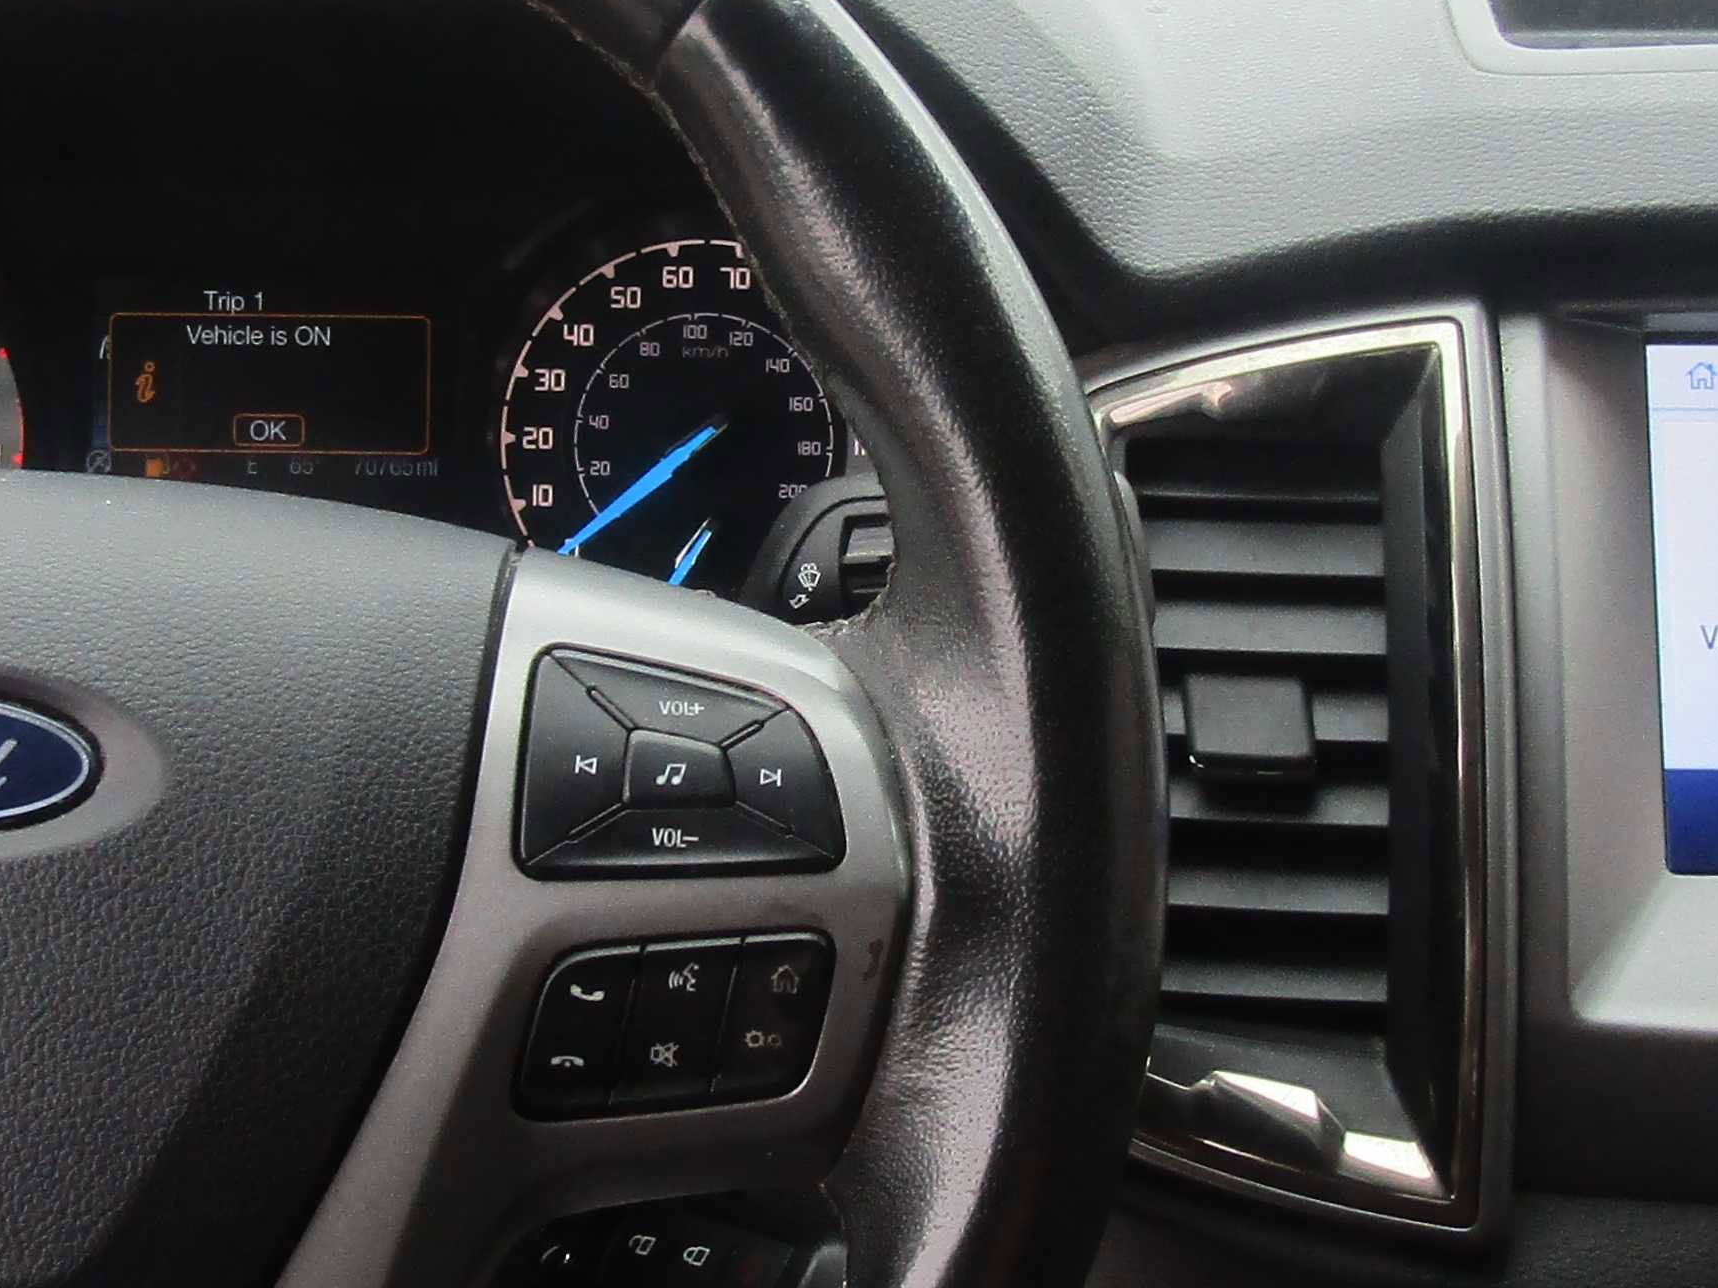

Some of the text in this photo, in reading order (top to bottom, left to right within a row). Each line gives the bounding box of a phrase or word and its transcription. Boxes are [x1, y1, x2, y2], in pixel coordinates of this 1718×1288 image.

[662, 266, 694, 289] 60
[720, 267, 751, 290] 70
[204, 290, 264, 314] Trip 1
[610, 286, 642, 309] 50
[186, 324, 331, 347] Vehicle is ON
[563, 323, 595, 347] 40
[683, 325, 708, 341] 100
[729, 331, 754, 347] 120
[639, 341, 661, 358] 80
[765, 358, 790, 374] 140
[534, 368, 566, 392] 30
[609, 373, 630, 390] 60
[789, 396, 814, 412] 160
[249, 420, 287, 441] OK
[589, 414, 610, 430] 40
[522, 427, 554, 450] 20
[797, 441, 822, 457] 180
[589, 461, 611, 477] 20
[532, 484, 553, 507] 10
